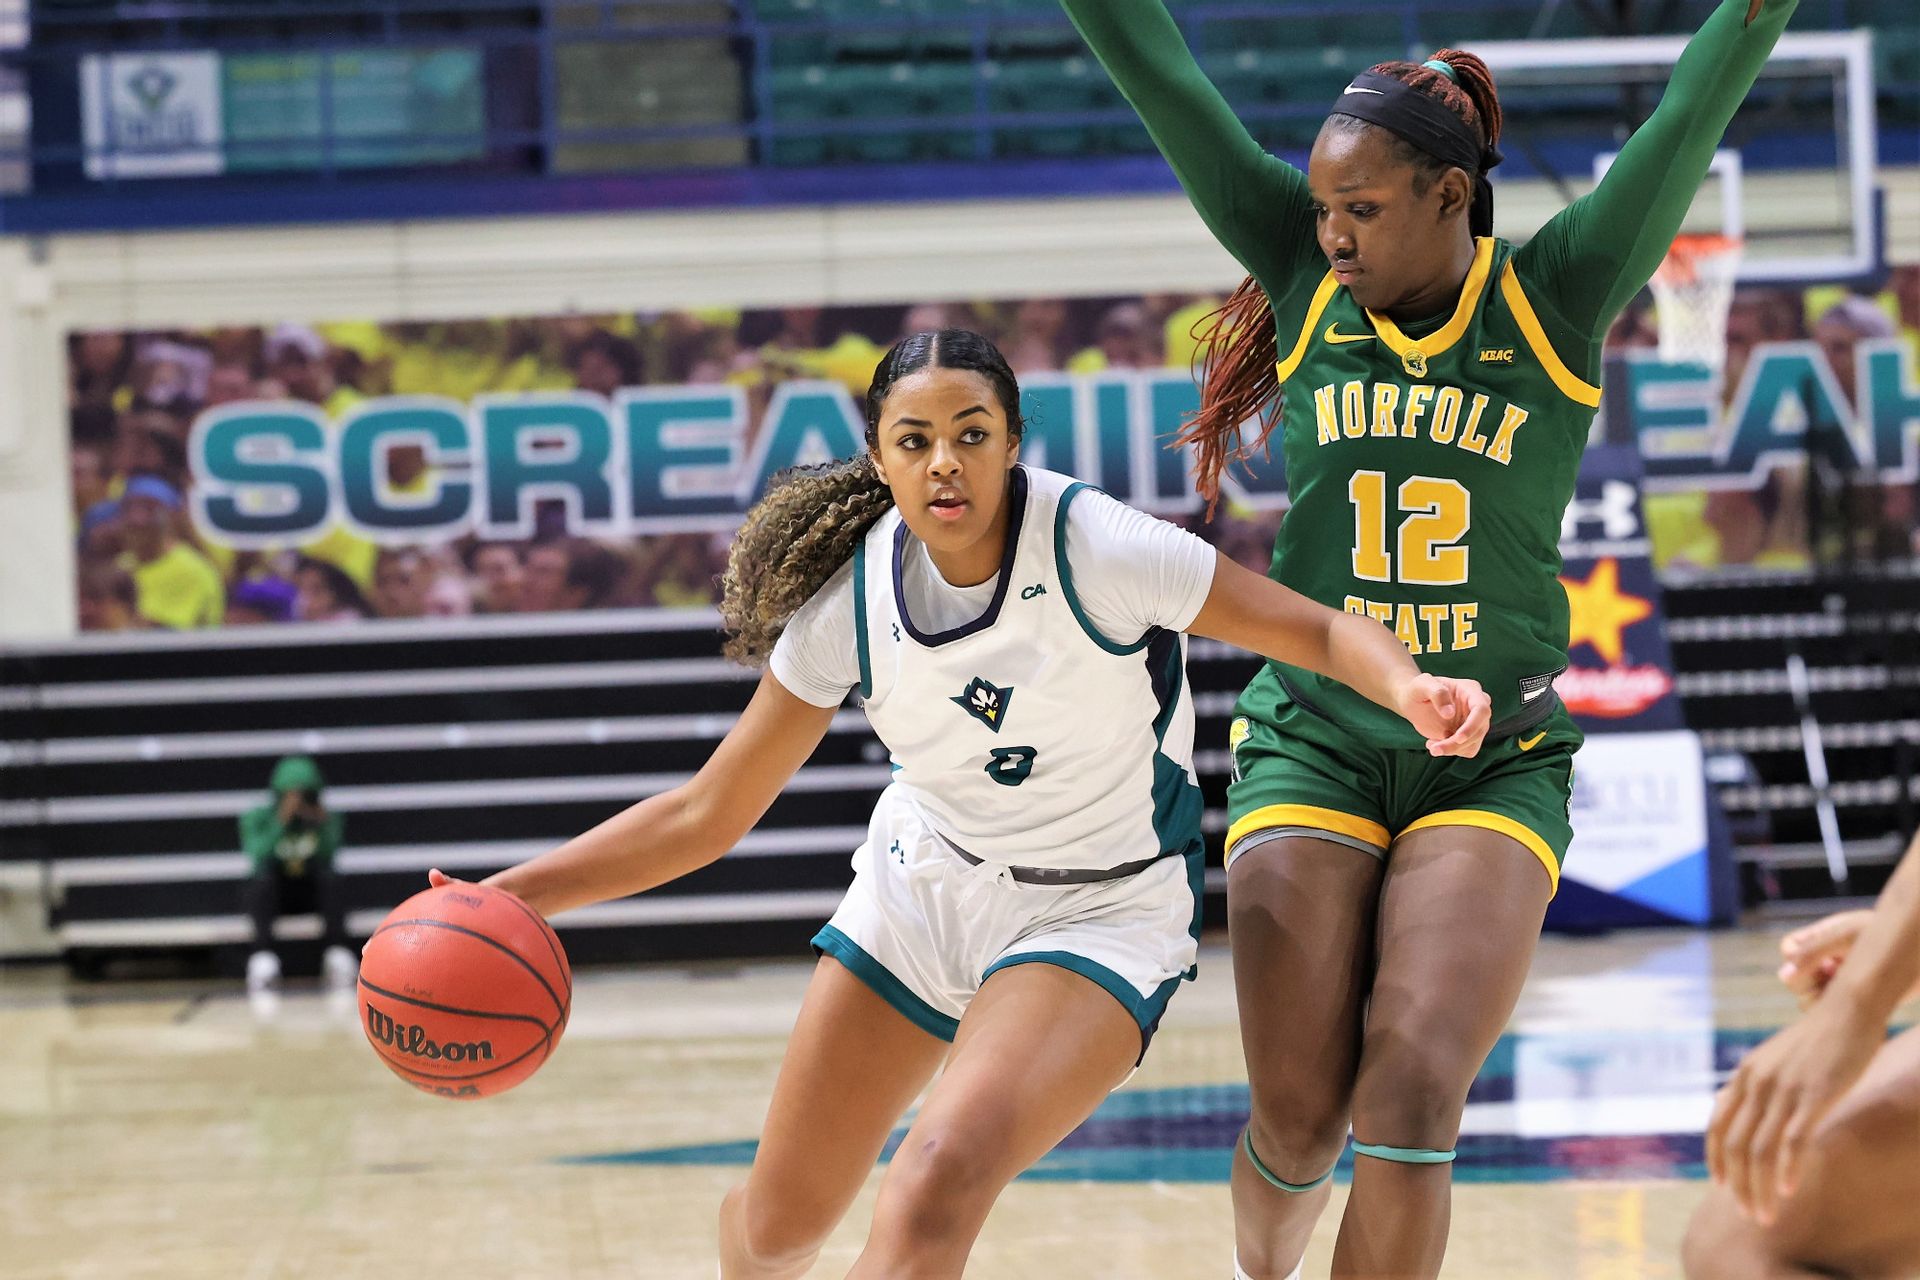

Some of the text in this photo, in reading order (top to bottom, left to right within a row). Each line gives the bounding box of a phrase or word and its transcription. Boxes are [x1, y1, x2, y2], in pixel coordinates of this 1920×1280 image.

[1479, 349, 1514, 363] MEAC
[1313, 379, 1529, 466] NORFOLK
[1348, 469, 1471, 586] 12
[366, 1000, 495, 1063] Wilson
